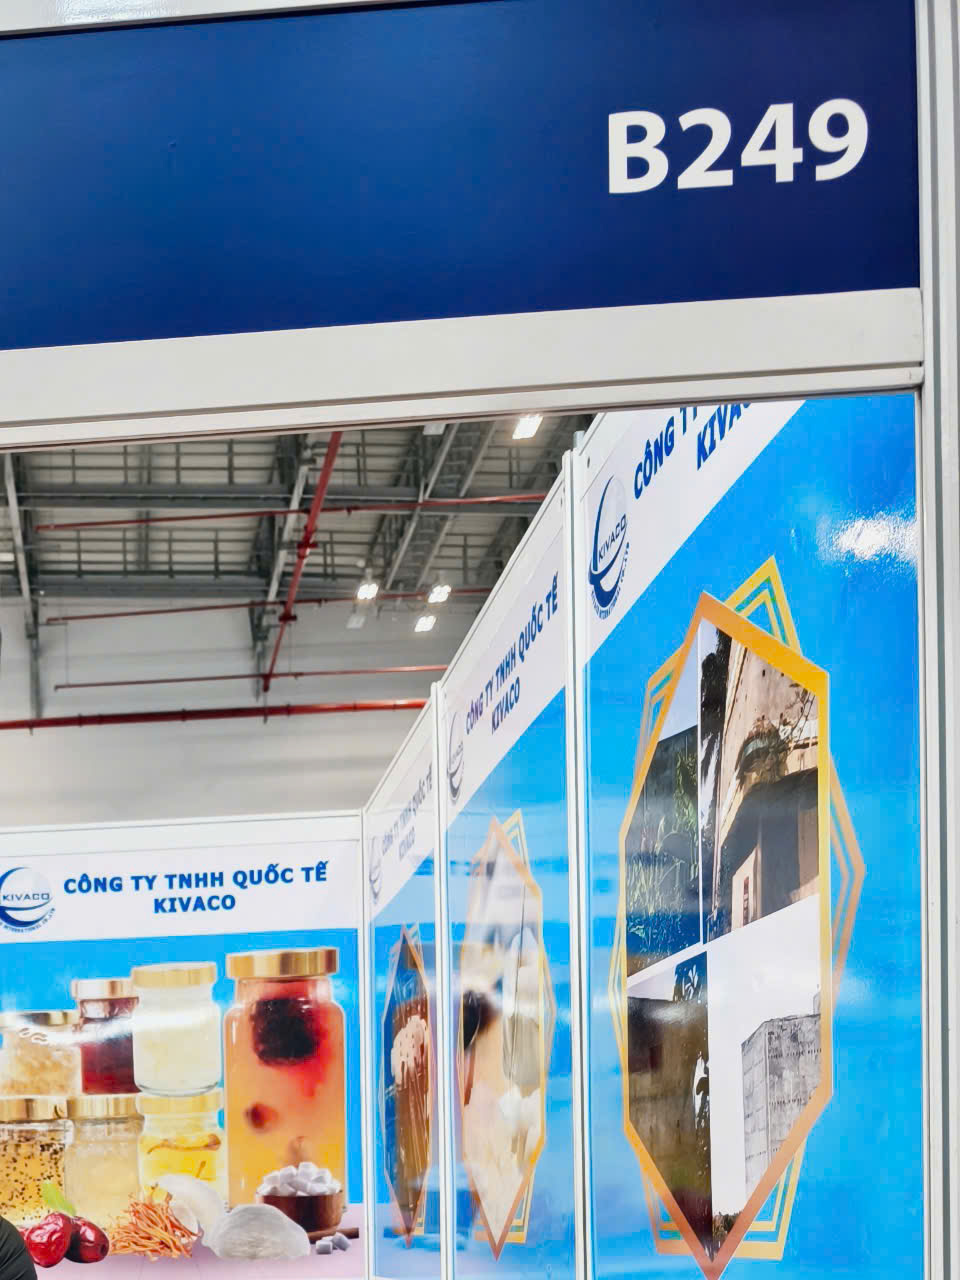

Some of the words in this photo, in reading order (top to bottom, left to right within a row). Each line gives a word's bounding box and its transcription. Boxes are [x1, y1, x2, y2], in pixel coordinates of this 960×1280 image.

[608, 98, 869, 194] B249
[634, 416, 675, 500] CÔNG
[697, 403, 751, 471] KIVA
[598, 513, 627, 563] KIVACO
[466, 691, 484, 734] CÔNG
[485, 675, 494, 708] TY
[495, 641, 516, 692] TNHH
[518, 601, 543, 663] QUỐC
[545, 571, 559, 621] TẾ
[491, 676, 520, 735] KIVACO
[2, 893, 50, 901] KIVACO
[64, 874, 123, 894] CÔNG
[131, 875, 157, 892] TY
[165, 872, 224, 889] TNHH
[232, 864, 293, 889] QUỐC
[301, 860, 329, 883] TẾ
[153, 894, 236, 914] KIVACO
